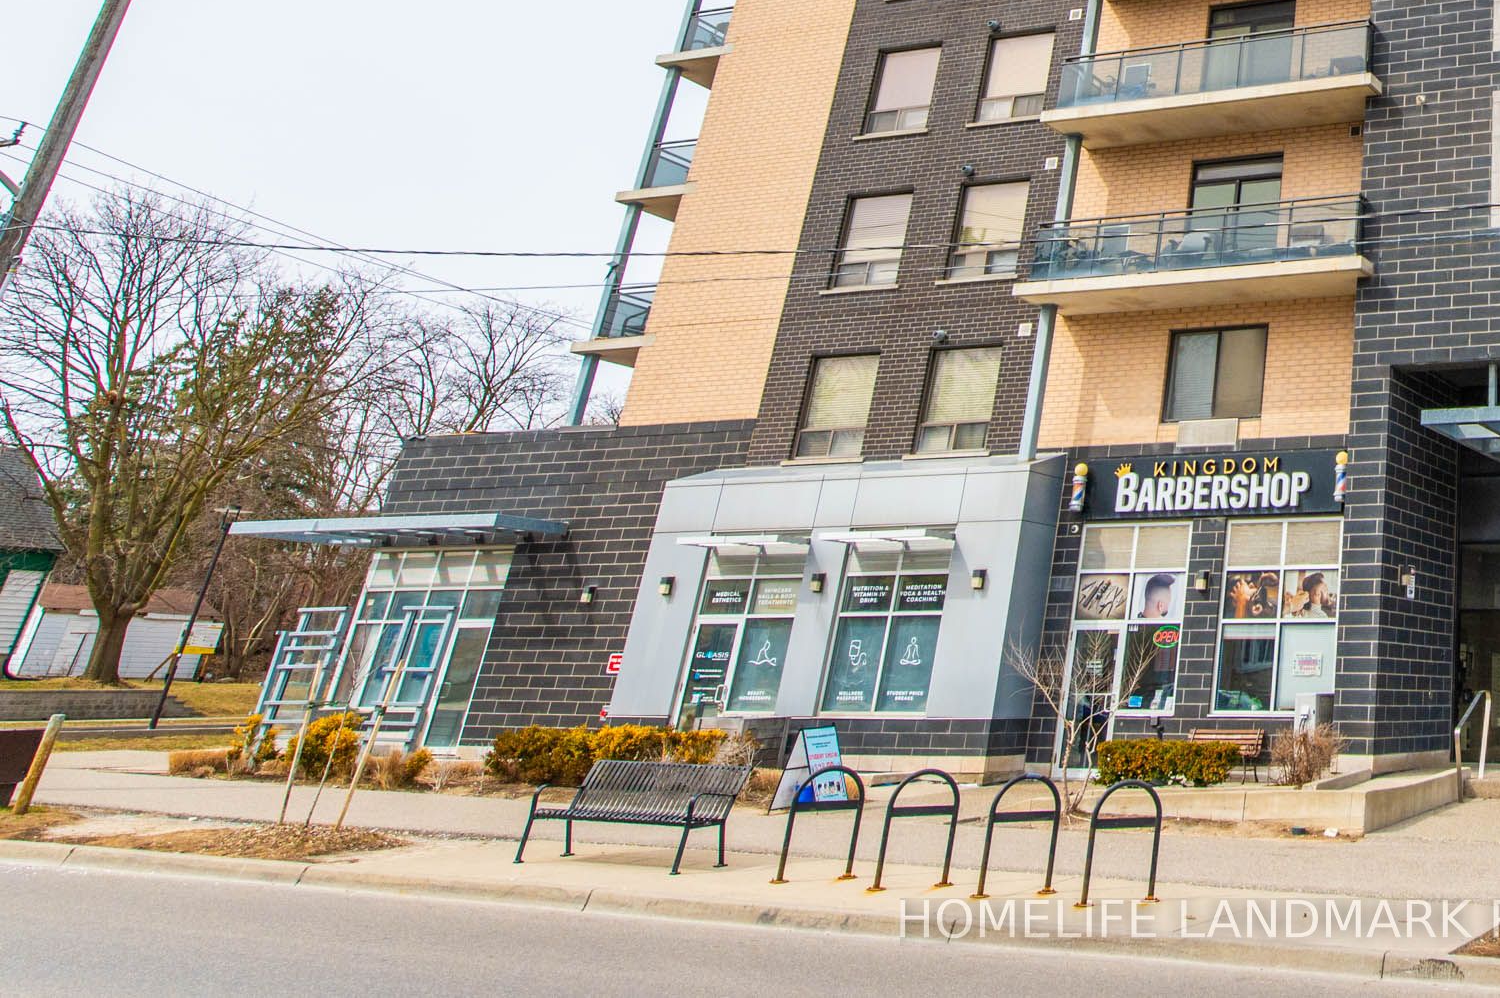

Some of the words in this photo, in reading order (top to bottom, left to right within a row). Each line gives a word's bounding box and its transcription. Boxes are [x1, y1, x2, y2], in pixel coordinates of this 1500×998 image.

[1153, 456, 1280, 477] KINGDOM
[1114, 471, 1310, 513] BARBERSHOP
[1153, 631, 1179, 643] OPEN
